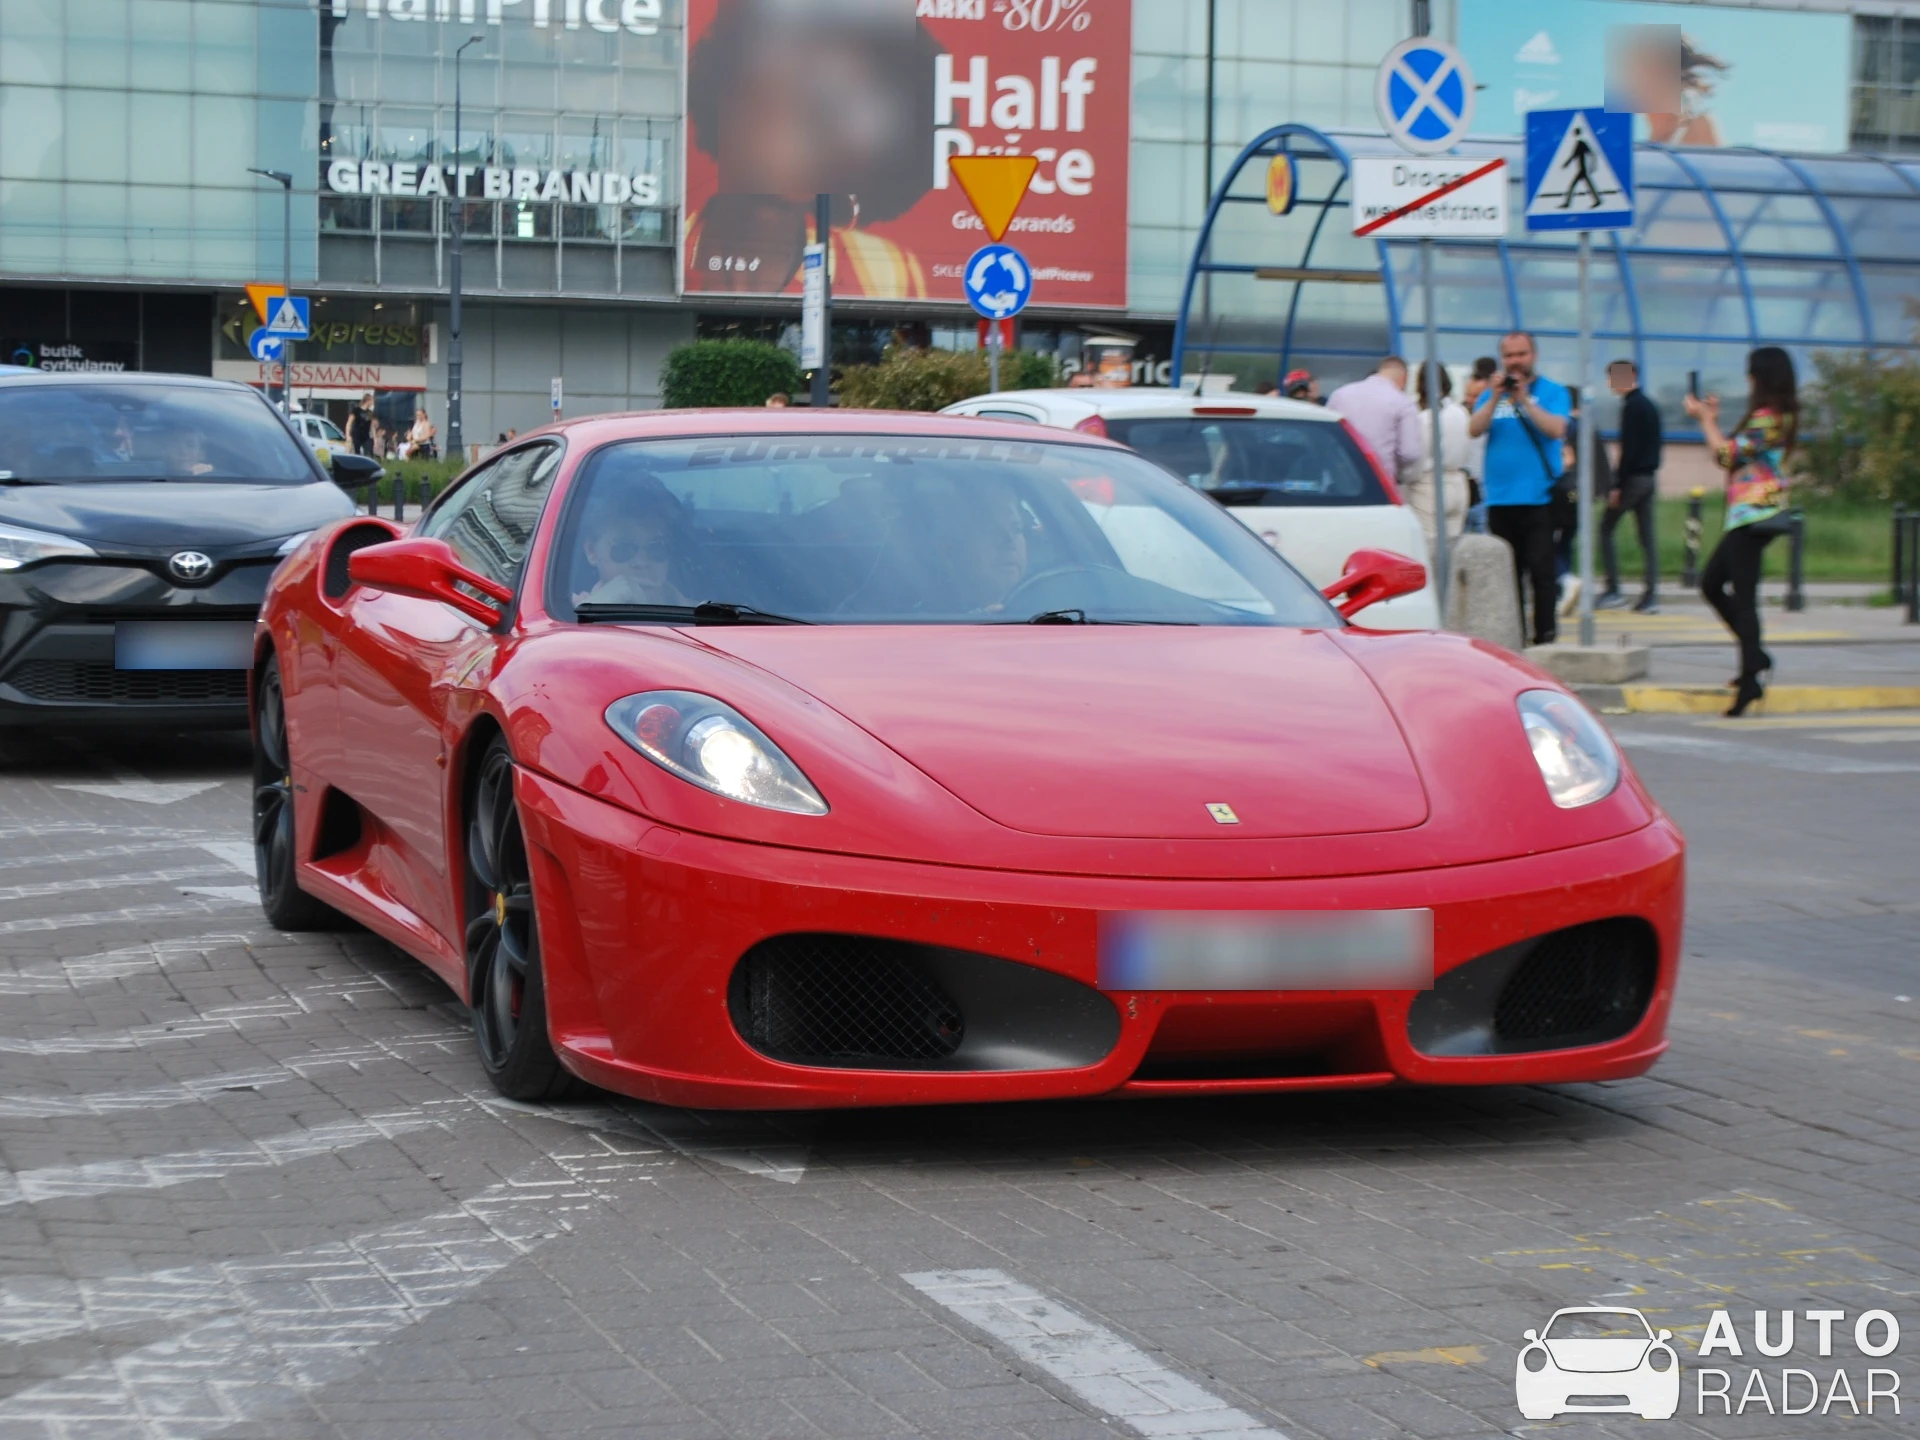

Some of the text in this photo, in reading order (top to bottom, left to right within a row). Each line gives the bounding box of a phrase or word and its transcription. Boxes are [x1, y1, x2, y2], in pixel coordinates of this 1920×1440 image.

[934, 54, 1098, 132] Half
[327, 160, 658, 206] GREAT BRANDS
[933, 128, 1096, 196] Pce
[40, 343, 83, 358] butik
[309, 318, 418, 350] xpress
